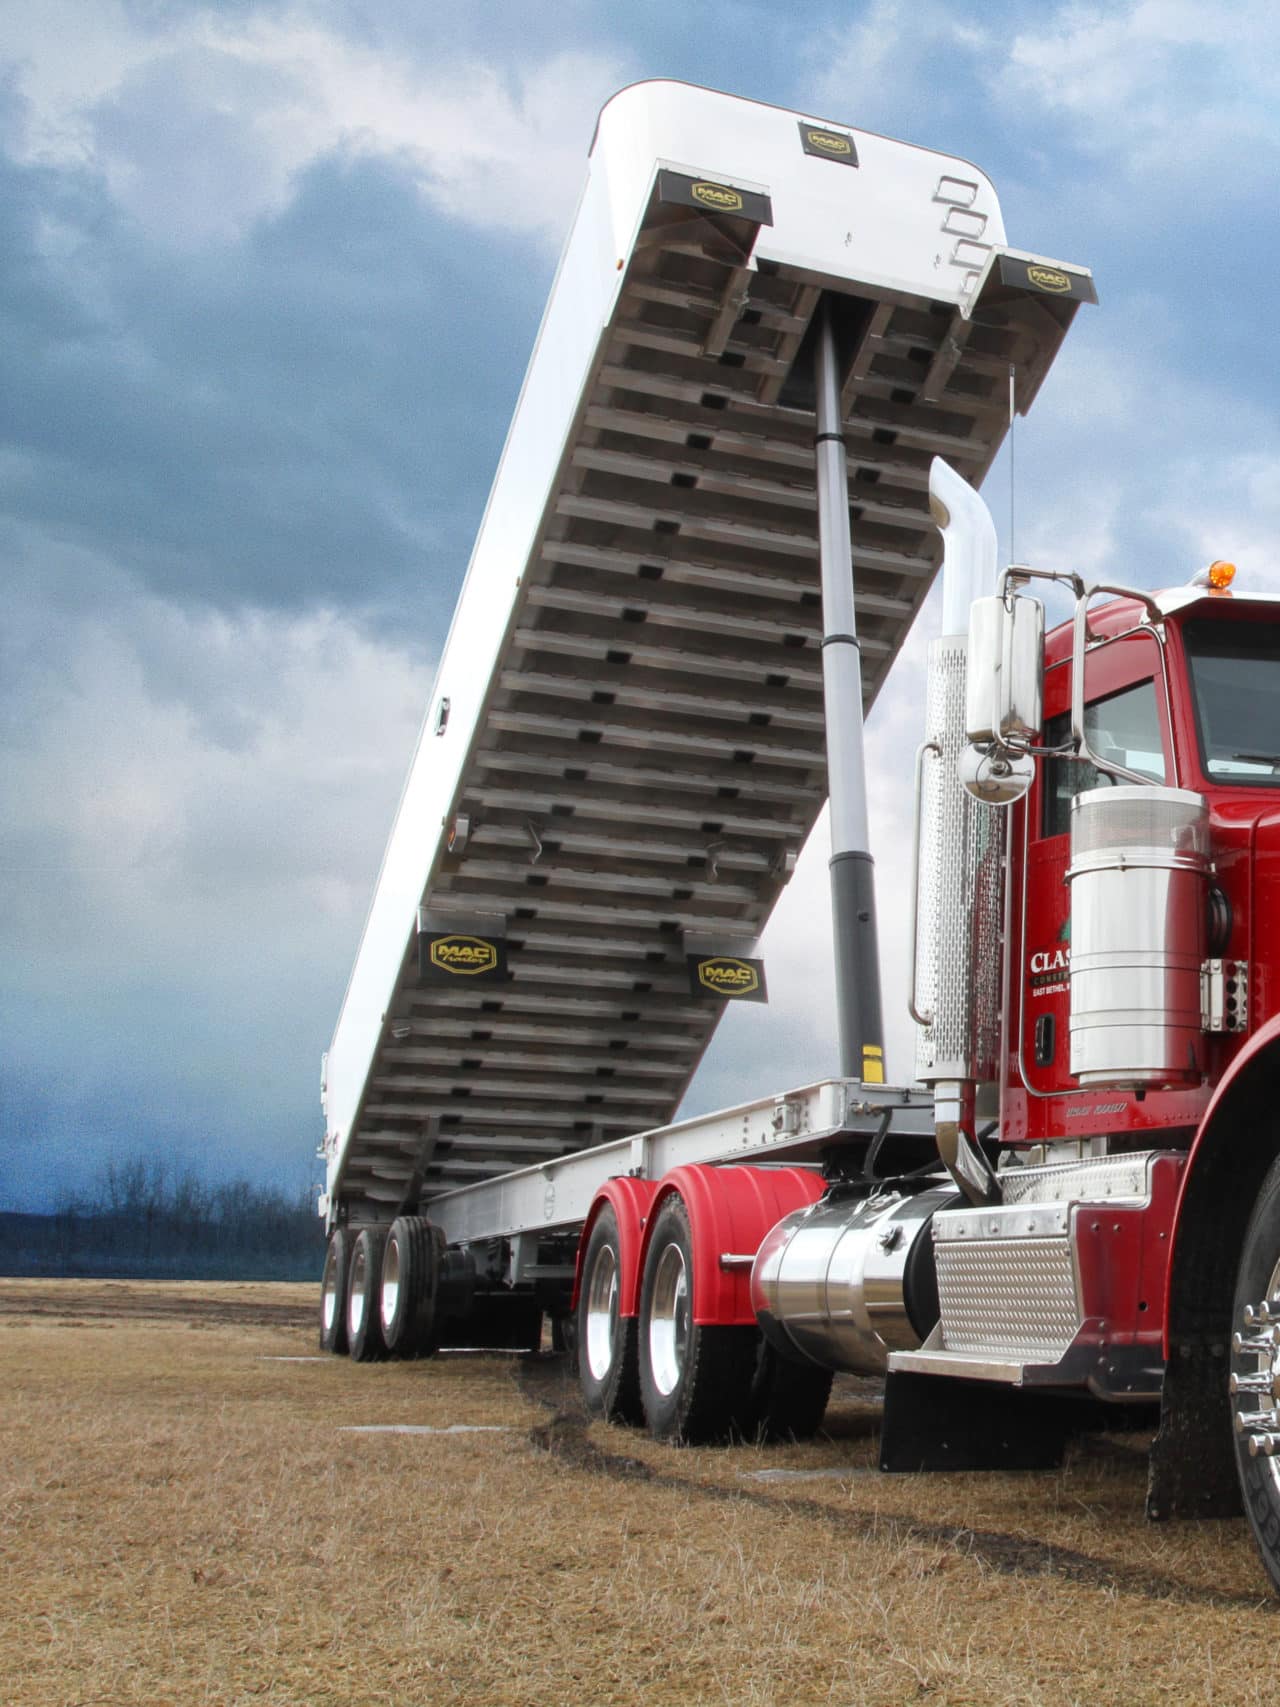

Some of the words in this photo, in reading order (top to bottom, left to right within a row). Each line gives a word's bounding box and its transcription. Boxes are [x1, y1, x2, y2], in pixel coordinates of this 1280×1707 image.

[812, 136, 846, 149] MAC
[697, 187, 737, 203] MAC
[1032, 271, 1066, 285] MAC
[438, 945, 490, 958] MAC
[705, 967, 751, 980] MAC
